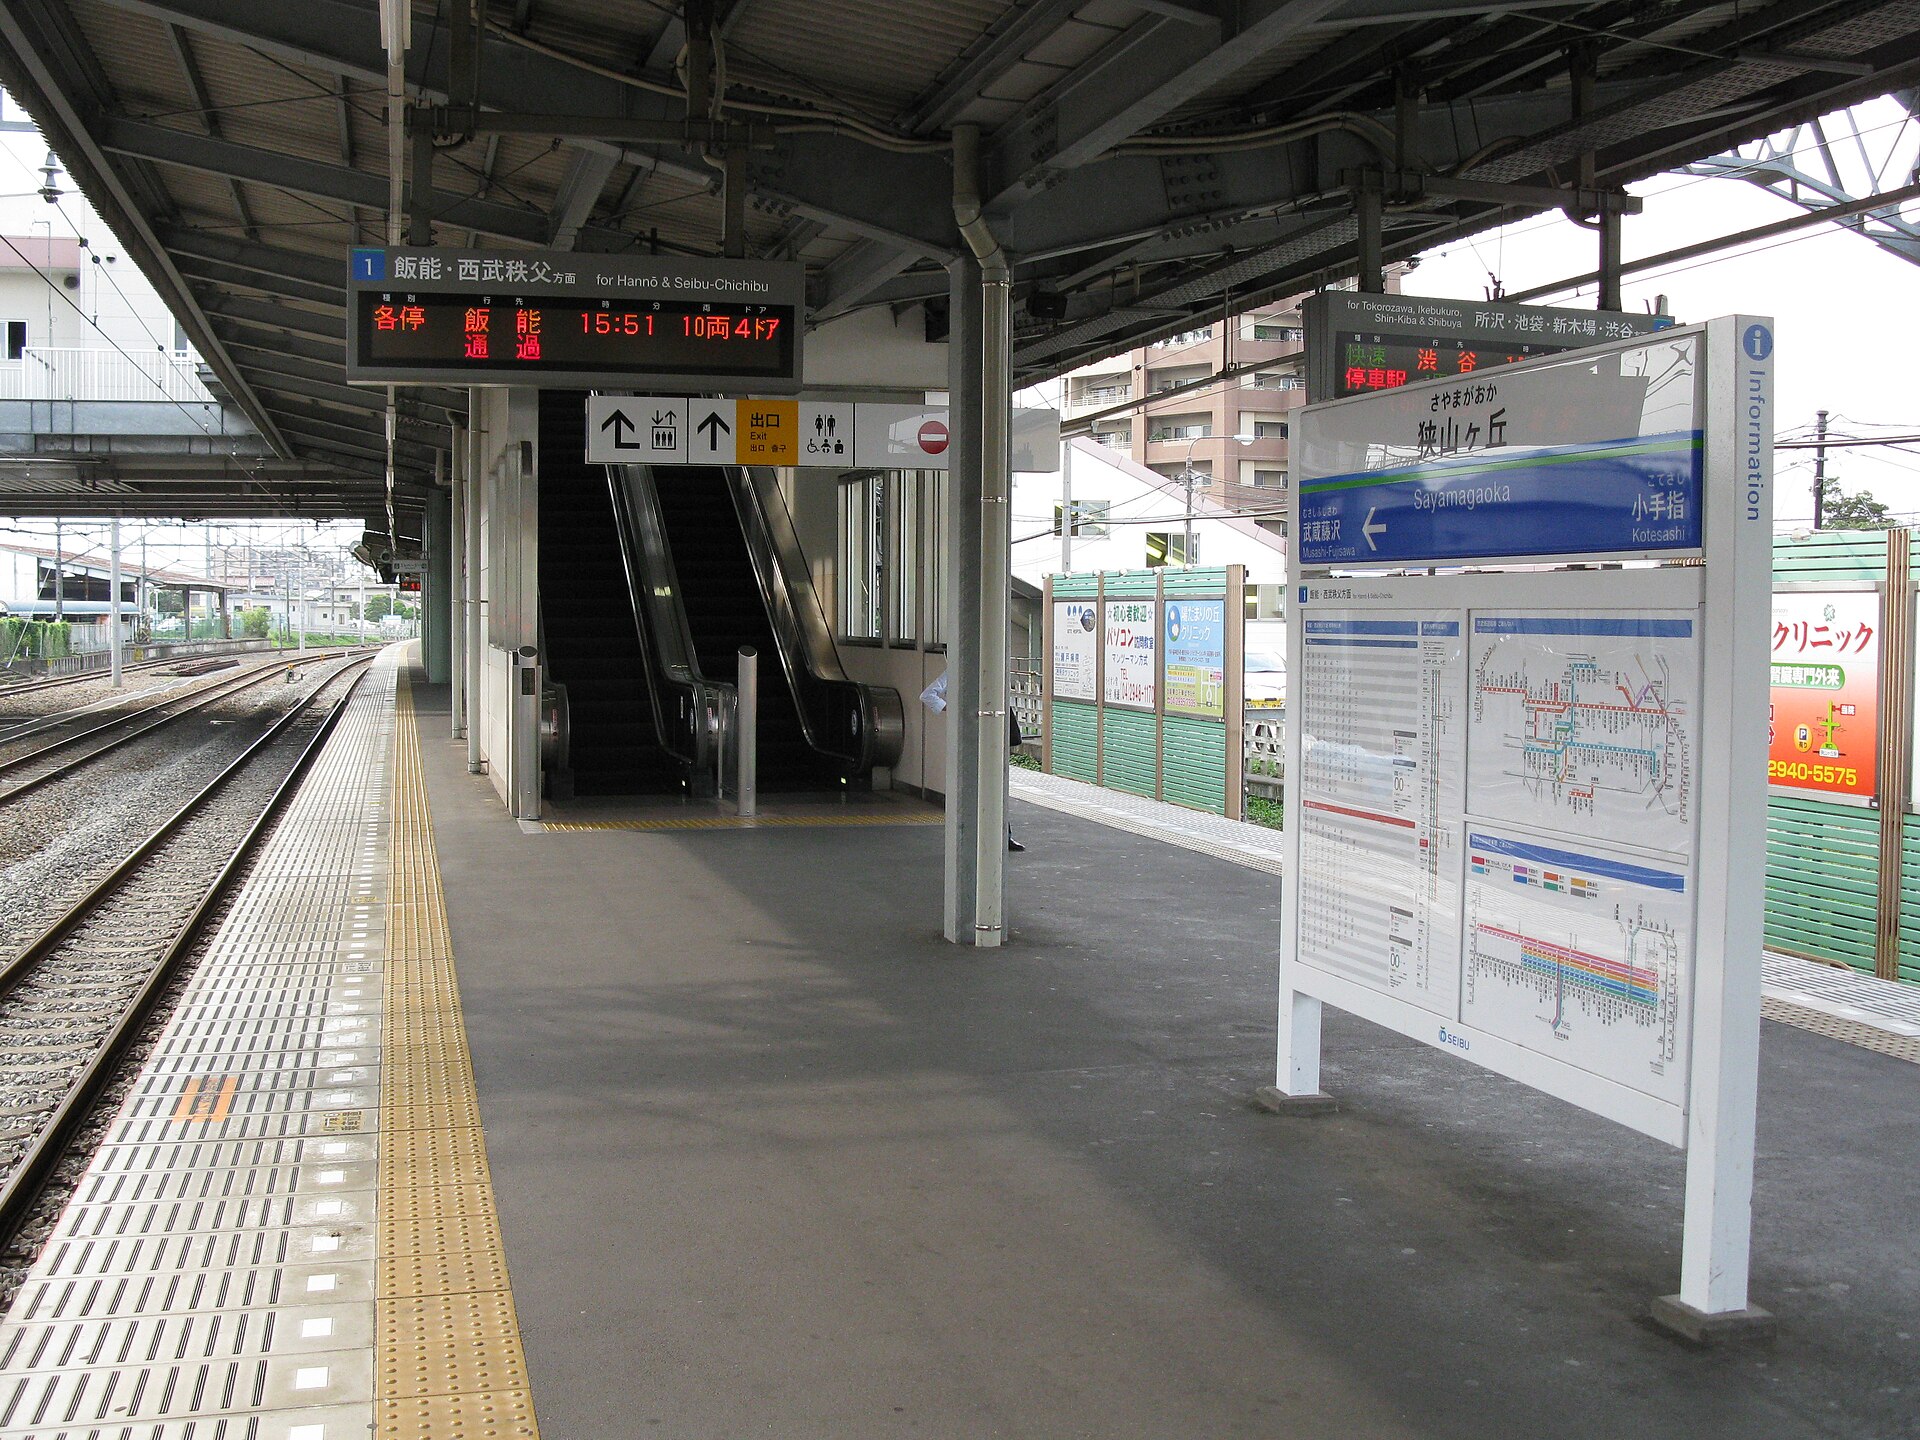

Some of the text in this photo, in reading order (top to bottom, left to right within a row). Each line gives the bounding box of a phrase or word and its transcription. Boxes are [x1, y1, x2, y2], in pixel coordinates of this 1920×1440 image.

[364, 258, 372, 275] 1
[596, 274, 769, 292] for Hannō & Seibu-Chichibu
[652, 302, 661, 310] 分
[745, 306, 767, 314] ドア
[1347, 300, 1462, 317] for Tokorozawa, Ikebukuro,
[374, 304, 425, 331] 各停
[464, 307, 541, 334] 飯能
[581, 313, 654, 336] 15:51
[1375, 313, 1462, 329] Shin-Kiba & Shibuya
[464, 333, 541, 360] 通過
[1345, 343, 1477, 373] 快速 渋谷
[1345, 367, 1407, 390] 停車駅
[1431, 383, 1498, 412] さやまがおか
[750, 411, 780, 428] 出口
[750, 431, 767, 440] Exit
[1747, 369, 1766, 521] Information
[1647, 472, 1685, 487] こてさし
[1413, 481, 1511, 513] Sayamagaoka
[1631, 490, 1685, 521] 小手指
[1303, 519, 1341, 542] 武蔵藤沢
[1632, 525, 1685, 543] Kotesashi
[1302, 545, 1356, 559] Musashi-Fujisawa
[1106, 627, 1134, 648] パソコン
[1772, 620, 1875, 655] クリニック
[1767, 759, 1858, 786] 2940-5575
[1446, 1033, 1471, 1051] SEIBU
